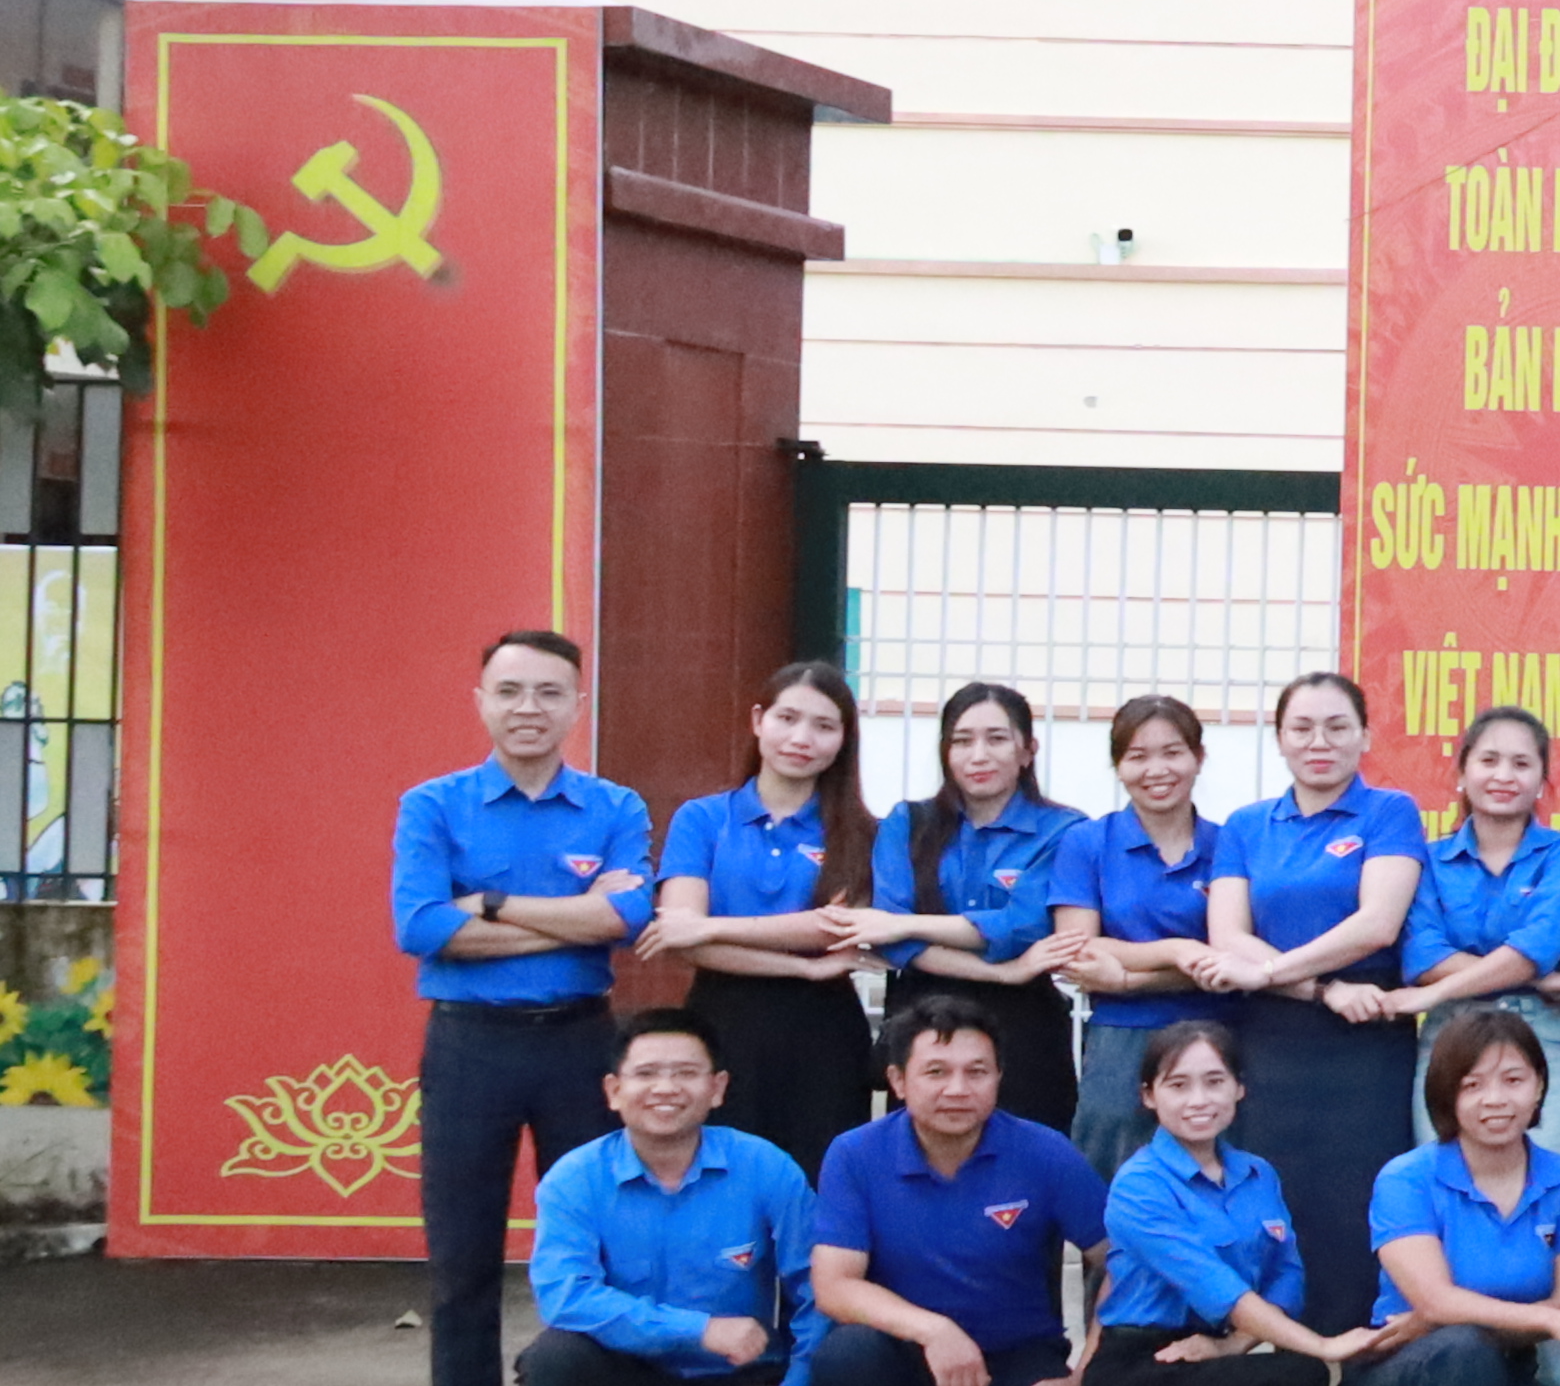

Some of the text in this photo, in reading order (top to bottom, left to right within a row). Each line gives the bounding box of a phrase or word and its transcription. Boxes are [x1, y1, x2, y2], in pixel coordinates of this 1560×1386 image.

[1466, 8, 1528, 111] ĐẠI
[1446, 149, 1543, 251] TOÀN
[1465, 289, 1543, 410] BẢN
[1371, 459, 1446, 569] SỨC
[1403, 633, 1482, 754] VIỆT
